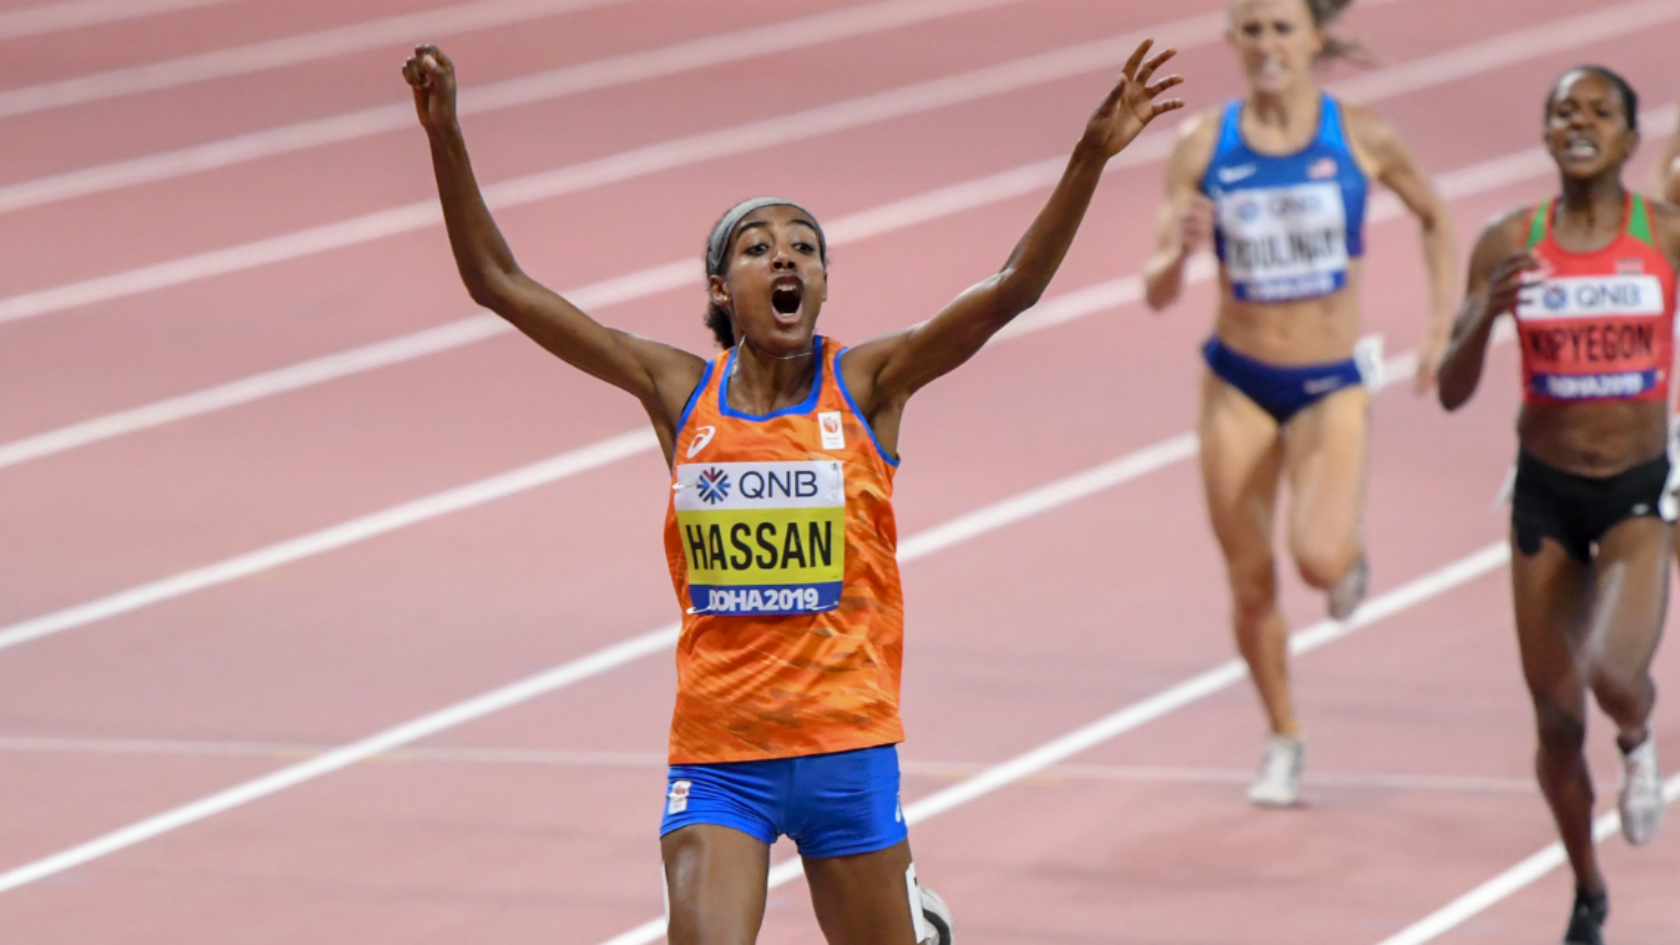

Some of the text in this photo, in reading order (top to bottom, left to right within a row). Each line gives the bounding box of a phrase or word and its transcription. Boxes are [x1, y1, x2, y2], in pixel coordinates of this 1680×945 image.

[1576, 283, 1642, 307] QNB
[738, 470, 818, 499] QNB
[685, 520, 832, 571] HASSAN
